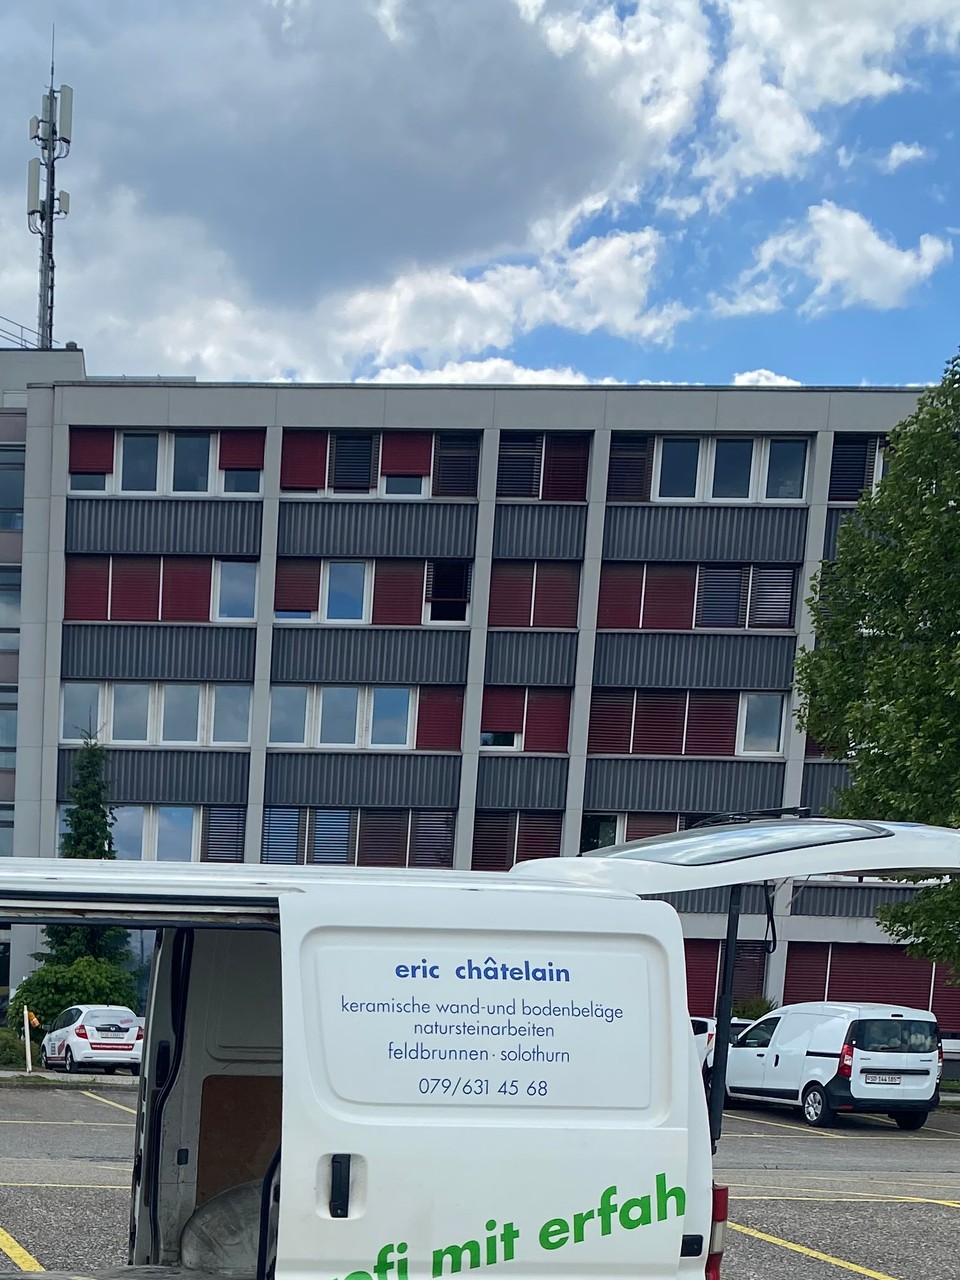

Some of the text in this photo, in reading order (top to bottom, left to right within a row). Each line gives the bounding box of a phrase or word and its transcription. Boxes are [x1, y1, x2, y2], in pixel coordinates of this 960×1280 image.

[394, 956, 571, 983] eric châtelain
[341, 995, 431, 1015] keramische
[521, 999, 624, 1022] bodenbeläge
[413, 1020, 555, 1038] natursteinarbeiten
[387, 1041, 570, 1064] feldbrunnen solothurn
[418, 1077, 548, 1097] 079/631 45 68
[432, 1219, 520, 1278] mit
[539, 1172, 686, 1251] erfah
